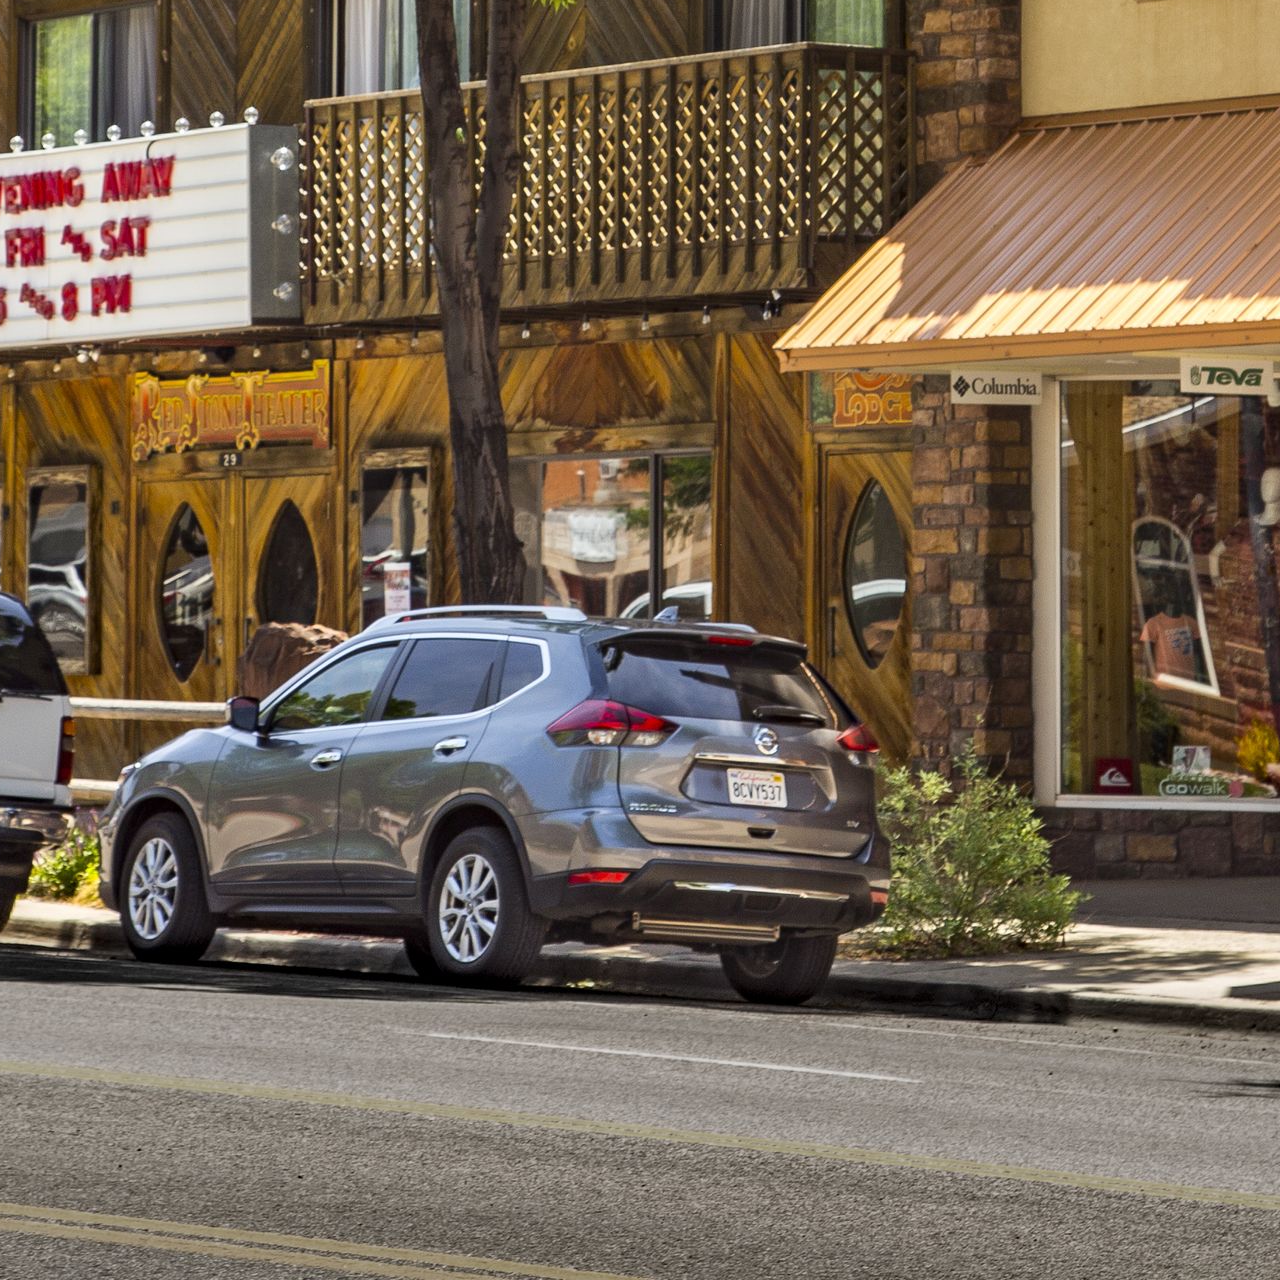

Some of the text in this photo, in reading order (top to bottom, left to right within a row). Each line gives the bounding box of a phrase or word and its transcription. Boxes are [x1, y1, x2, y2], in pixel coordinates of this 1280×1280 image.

[101, 155, 176, 203] AWAY
[5, 226, 45, 268] FRI
[99, 216, 151, 261] SAT
[62, 281, 79, 321] 8
[90, 273, 133, 316] PM
[971, 377, 1038, 396] Columbia
[223, 453, 237, 466] 29
[732, 781, 782, 802] 8CVY537
